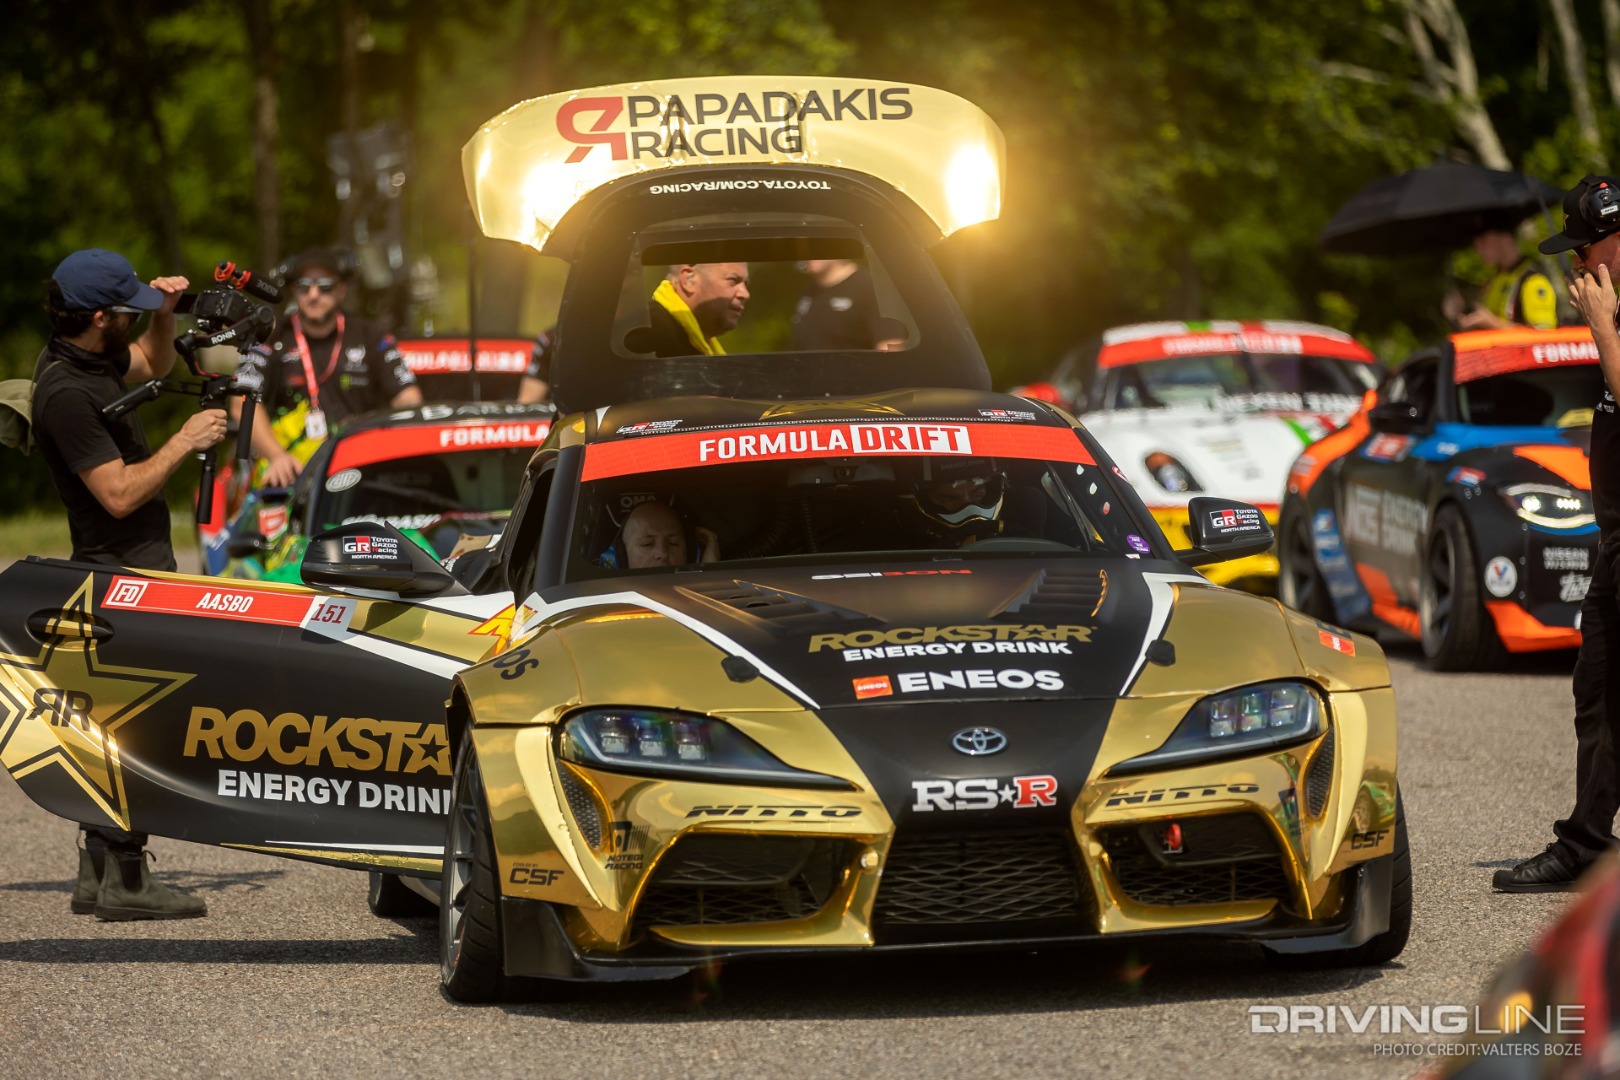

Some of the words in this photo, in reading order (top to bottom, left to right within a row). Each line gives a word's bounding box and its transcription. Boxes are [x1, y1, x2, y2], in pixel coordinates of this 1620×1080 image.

[628, 87, 913, 127] PAPADAKIS
[631, 126, 803, 160] RACING
[650, 179, 831, 195] TOYOTA.COM/RACING
[211, 329, 236, 344] RONIN
[440, 425, 550, 447] FORMULA
[699, 429, 849, 462] FORMULA
[857, 425, 961, 451] DRIFT
[1212, 513, 1236, 528] GR
[344, 540, 370, 553] GR
[115, 584, 140, 602] FD
[196, 592, 254, 613] AASBO
[310, 603, 347, 624] 151
[808, 624, 1093, 653] ROCKSTAR
[843, 641, 967, 662] ENERGY
[971, 641, 1073, 655] DRINK
[856, 681, 888, 692] ENEOS
[897, 669, 1064, 693] ENEOS
[183, 706, 452, 776] ROCKSTA
[217, 769, 352, 806] ENERGY
[1106, 783, 1259, 808] NITTO
[685, 805, 862, 818] NITTO
[1351, 830, 1389, 850] CSF
[509, 868, 564, 886] CSF
